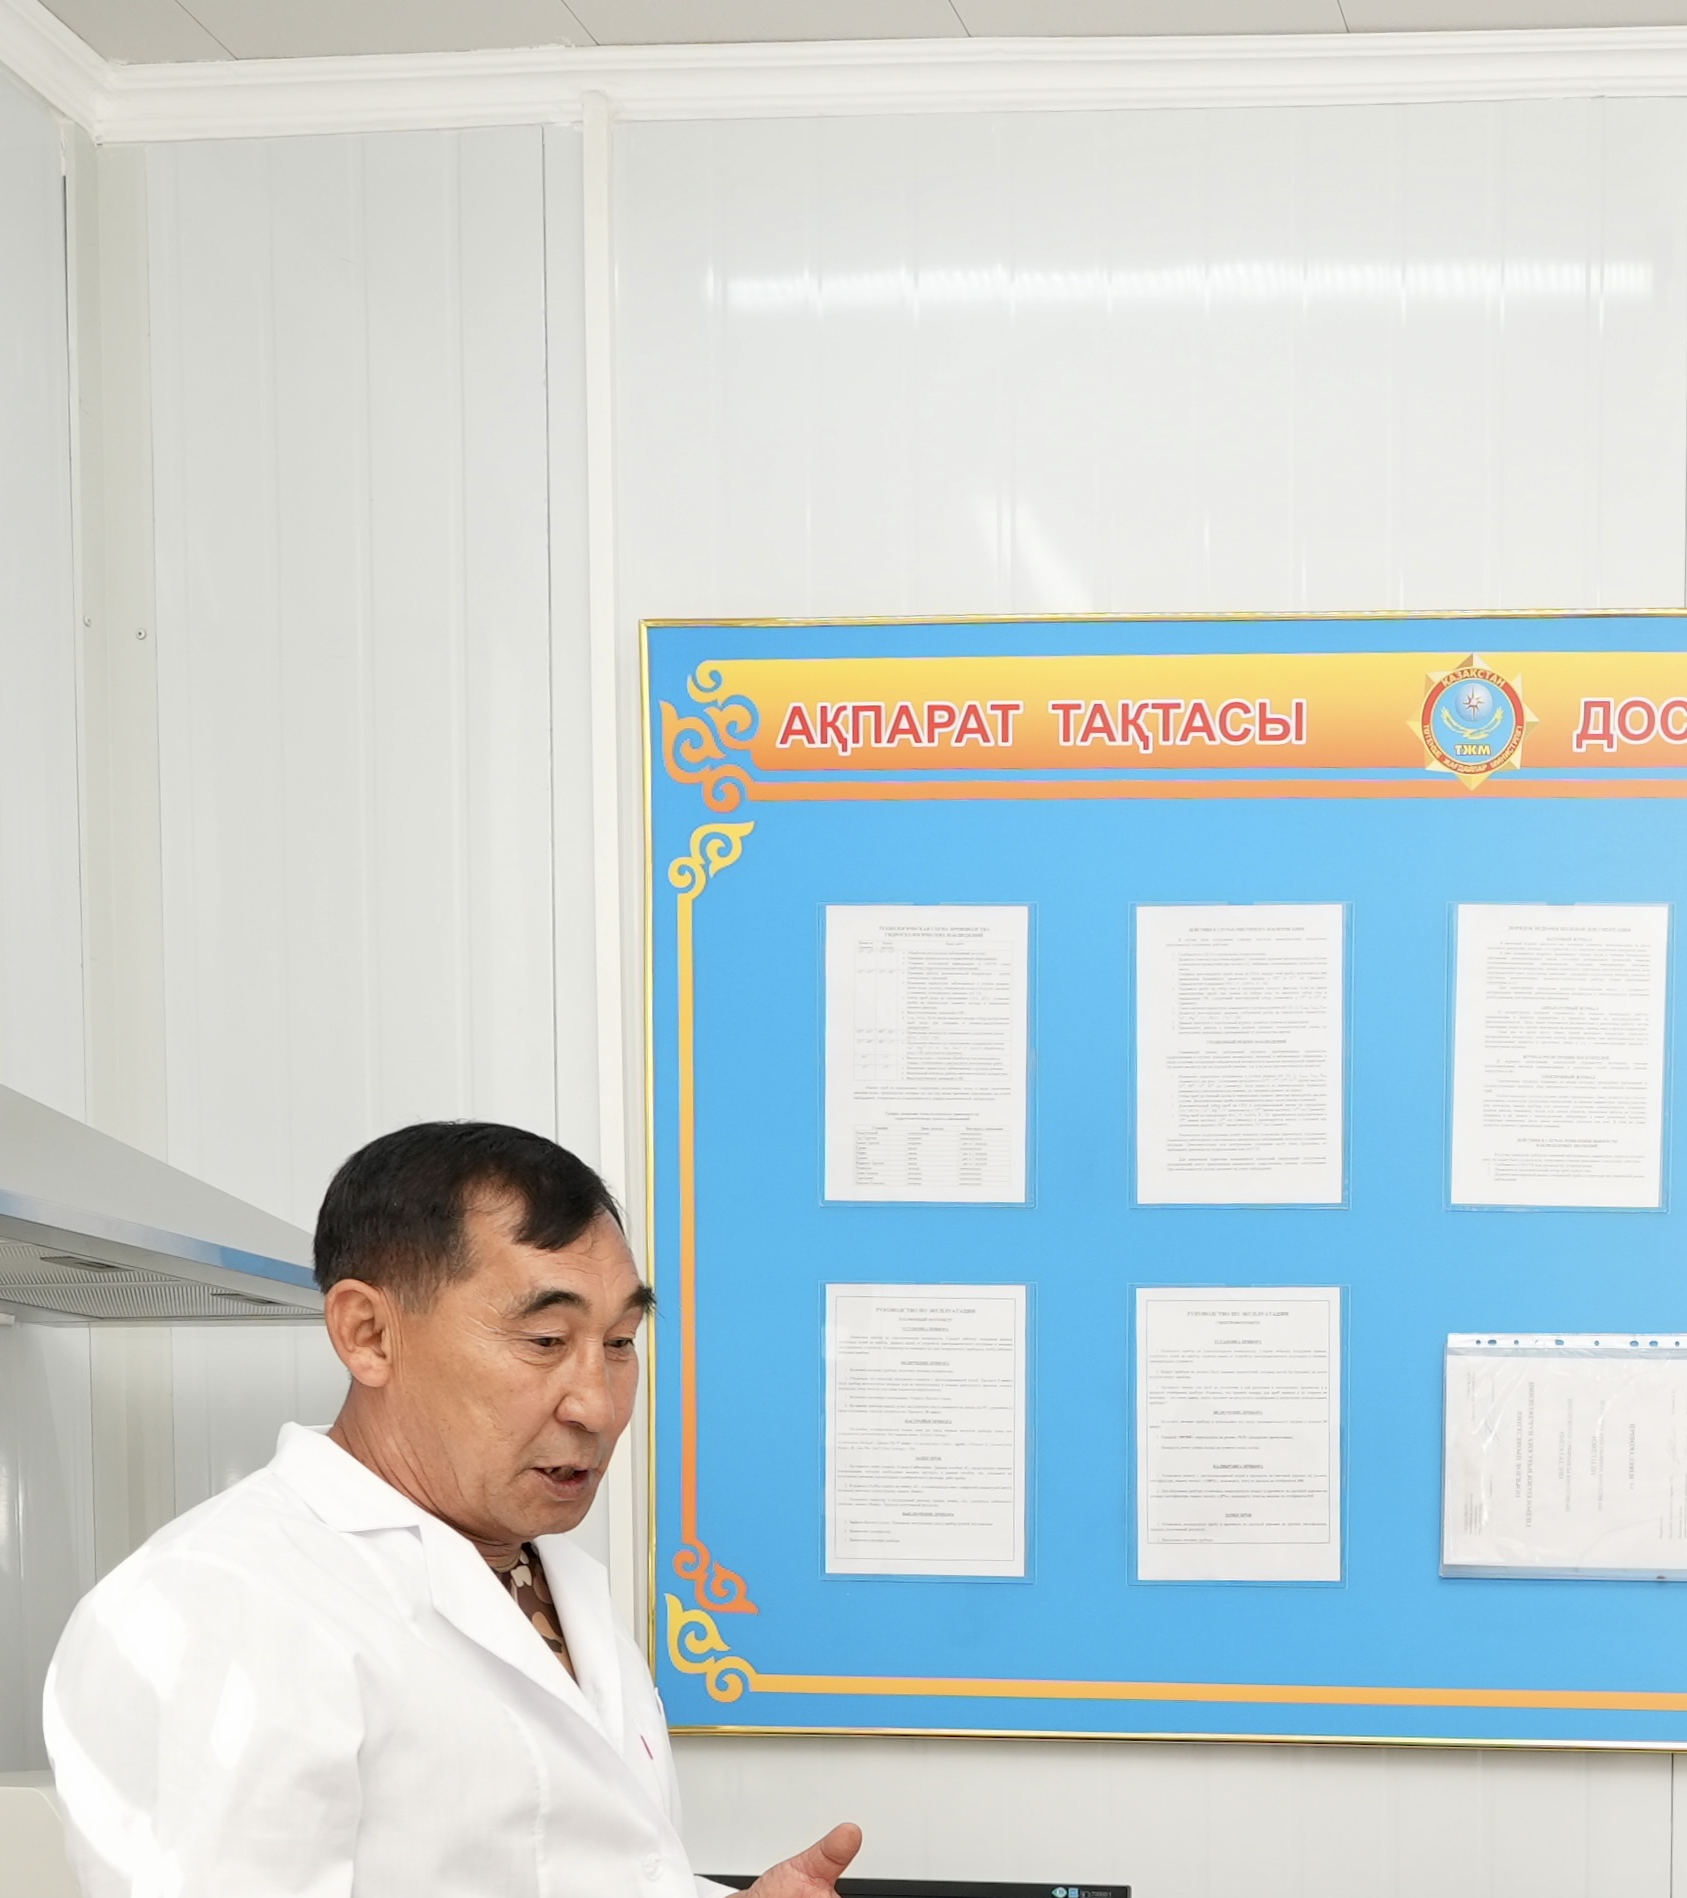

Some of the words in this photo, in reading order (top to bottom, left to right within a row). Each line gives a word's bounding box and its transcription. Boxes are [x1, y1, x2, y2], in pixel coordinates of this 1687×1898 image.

[778, 699, 1024, 753] АҚПАРАТ
[1051, 698, 1307, 752] ТАҚТАСЫ
[1454, 743, 1492, 757] ТЖМ
